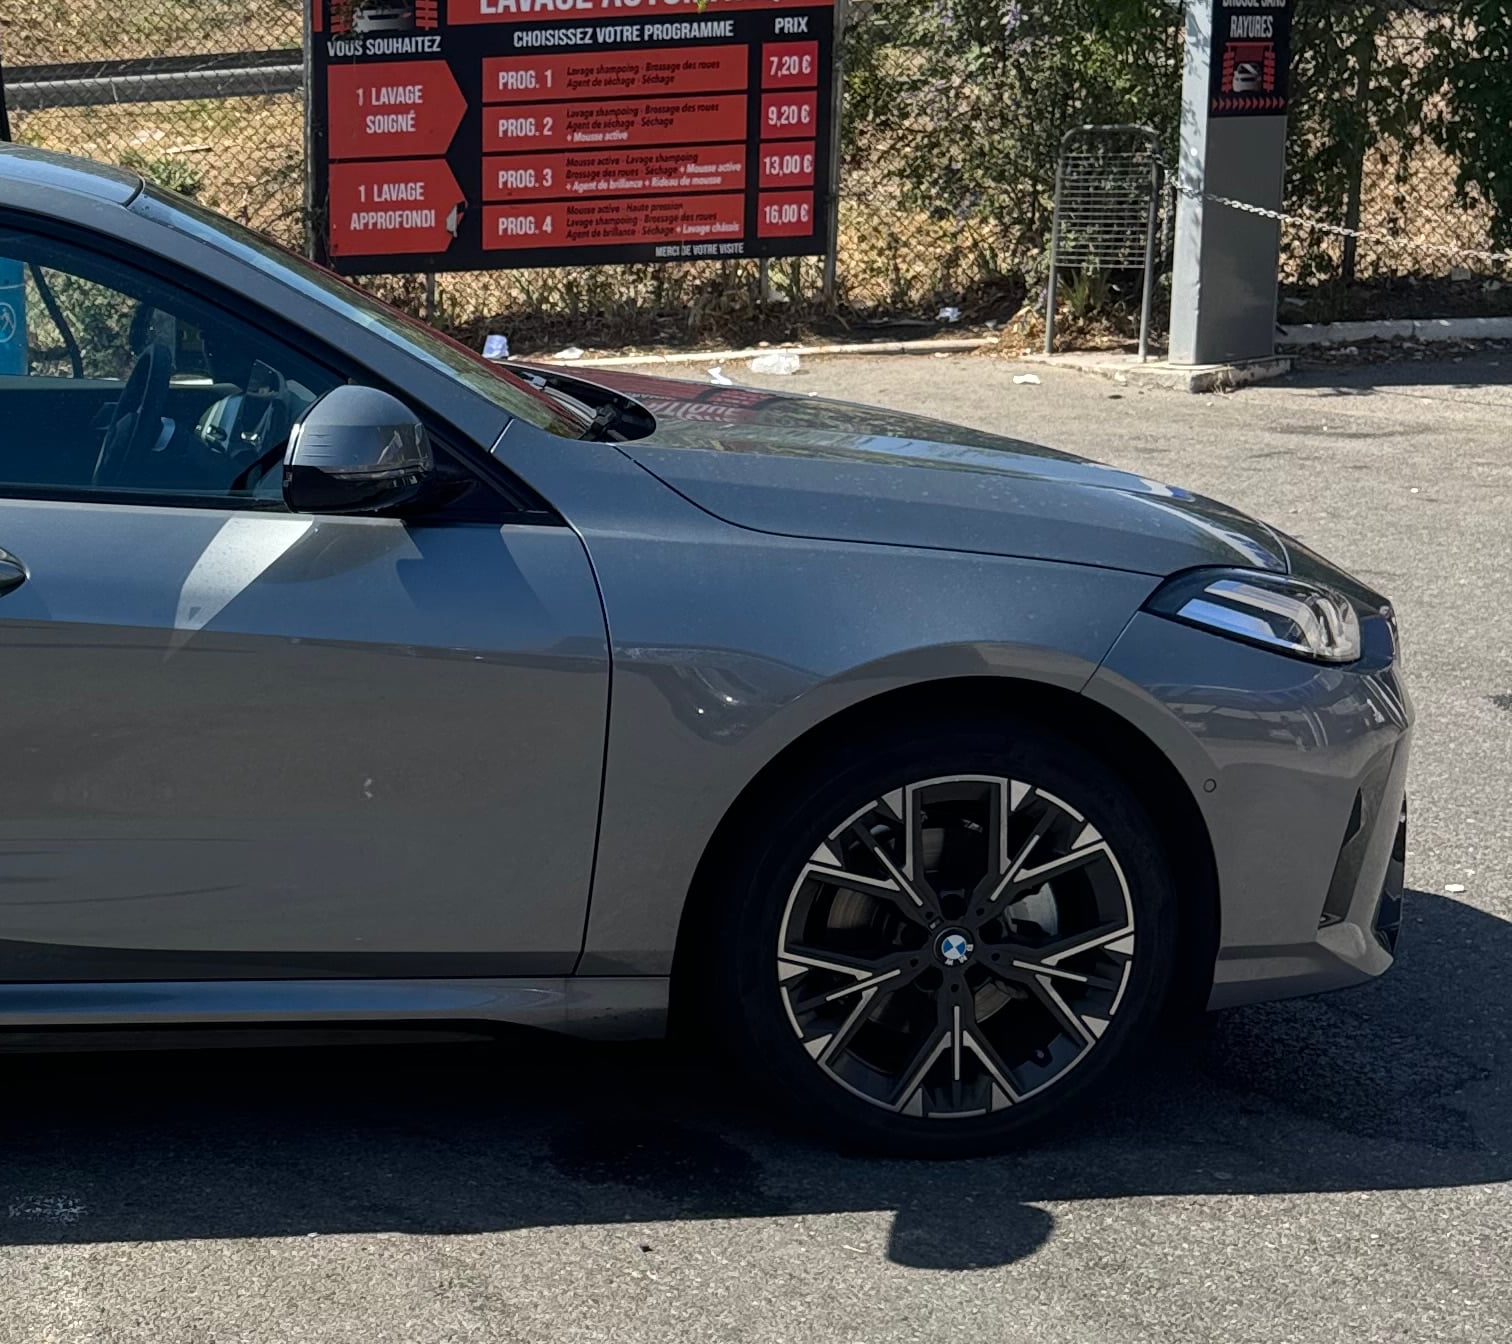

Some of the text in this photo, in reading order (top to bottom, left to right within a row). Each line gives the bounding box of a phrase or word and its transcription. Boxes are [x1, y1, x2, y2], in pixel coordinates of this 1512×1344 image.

[513, 20, 735, 48] CHOISISSEZ VOTRE PROGRAMME
[774, 16, 809, 34] PRIX
[1230, 15, 1274, 38] RAYURES
[327, 36, 442, 57] VOUS SOUHAITEZ
[567, 66, 594, 78] Lavage
[645, 61, 680, 73] Brossage
[769, 55, 811, 78] 7,20 €
[498, 69, 553, 90] PROG. 1
[592, 77, 602, 87] de
[356, 85, 423, 106] 1 LAVAGE
[366, 110, 416, 134] SOIGNÉ
[567, 108, 594, 120] Lavage
[645, 104, 680, 116] Brossage
[768, 105, 810, 128] 9,20 €
[498, 117, 553, 138] PROG. 2
[591, 119, 602, 129] de
[763, 154, 813, 176] 13,00 €
[498, 168, 552, 189] PROG. 3
[358, 182, 425, 203] 1 LAVAGE
[350, 209, 435, 230] APPROFONDI
[764, 203, 809, 225] 16,00 €
[498, 215, 552, 236] PROG. 4
[655, 242, 744, 257] MERCI DE VOTRE VISITE
